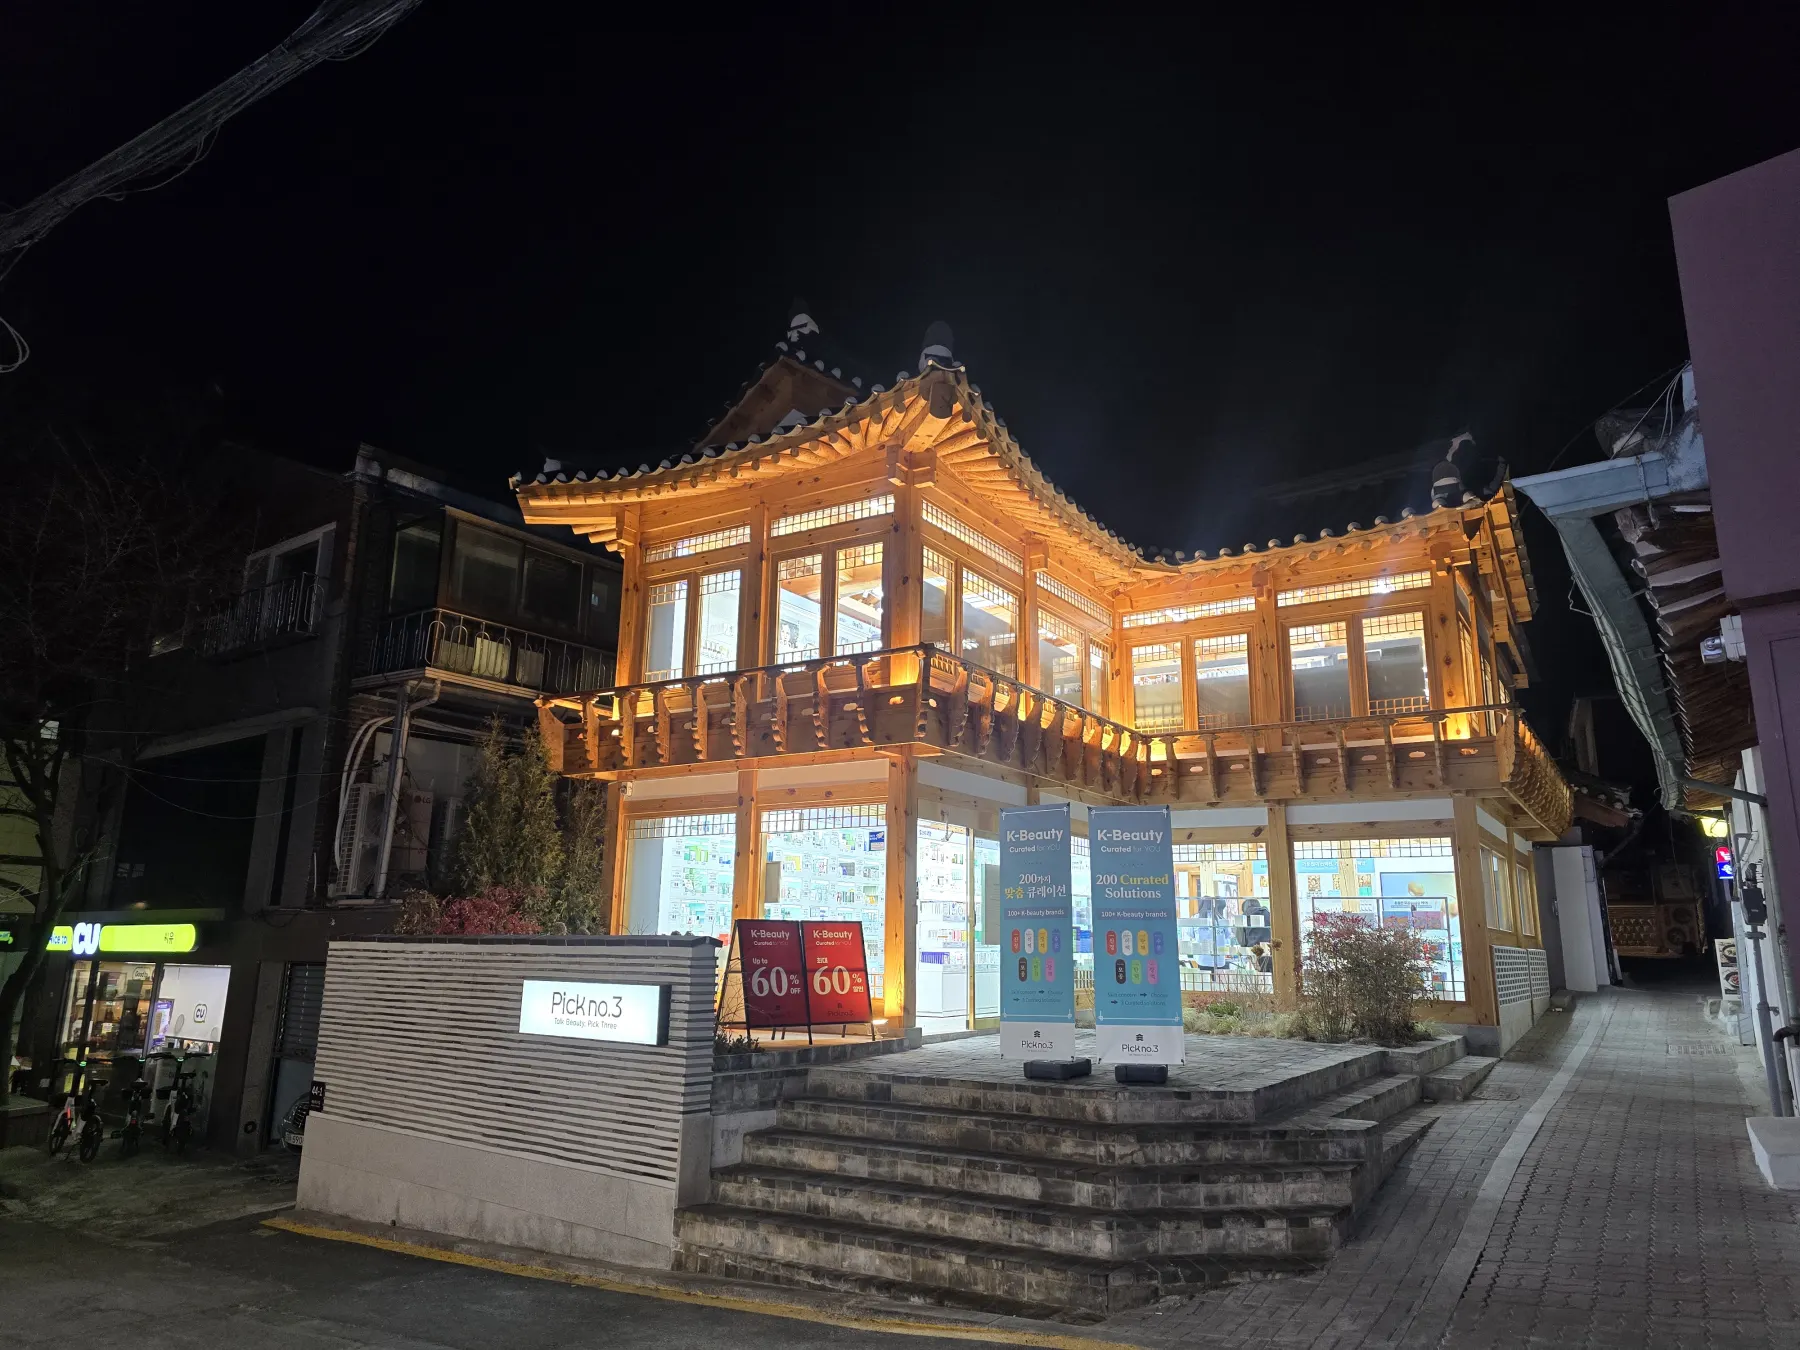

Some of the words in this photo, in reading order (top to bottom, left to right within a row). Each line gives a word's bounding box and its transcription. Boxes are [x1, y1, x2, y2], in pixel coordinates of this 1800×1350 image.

[1006, 829, 1064, 842] K-Beauty
[1097, 829, 1163, 844] K-Beauty
[1009, 845, 1036, 853] Curated
[1100, 845, 1132, 853] Curated
[1144, 845, 1161, 853] YOU
[1096, 874, 1118, 885] 200
[1120, 874, 1169, 885] Curated
[1027, 884, 1067, 899] 큐레이션
[1105, 887, 1162, 899] Solutions
[73, 922, 101, 954] CU
[751, 929, 790, 940] K-Beauty
[813, 929, 853, 940] K-Beauty
[751, 966, 789, 997] 60
[790, 987, 801, 995] OFF
[813, 965, 851, 995] 60
[554, 1017, 565, 1025] Talk
[587, 1020, 600, 1028] Pick
[601, 1020, 618, 1030] Three
[311, 1085, 323, 1097] 44-1
